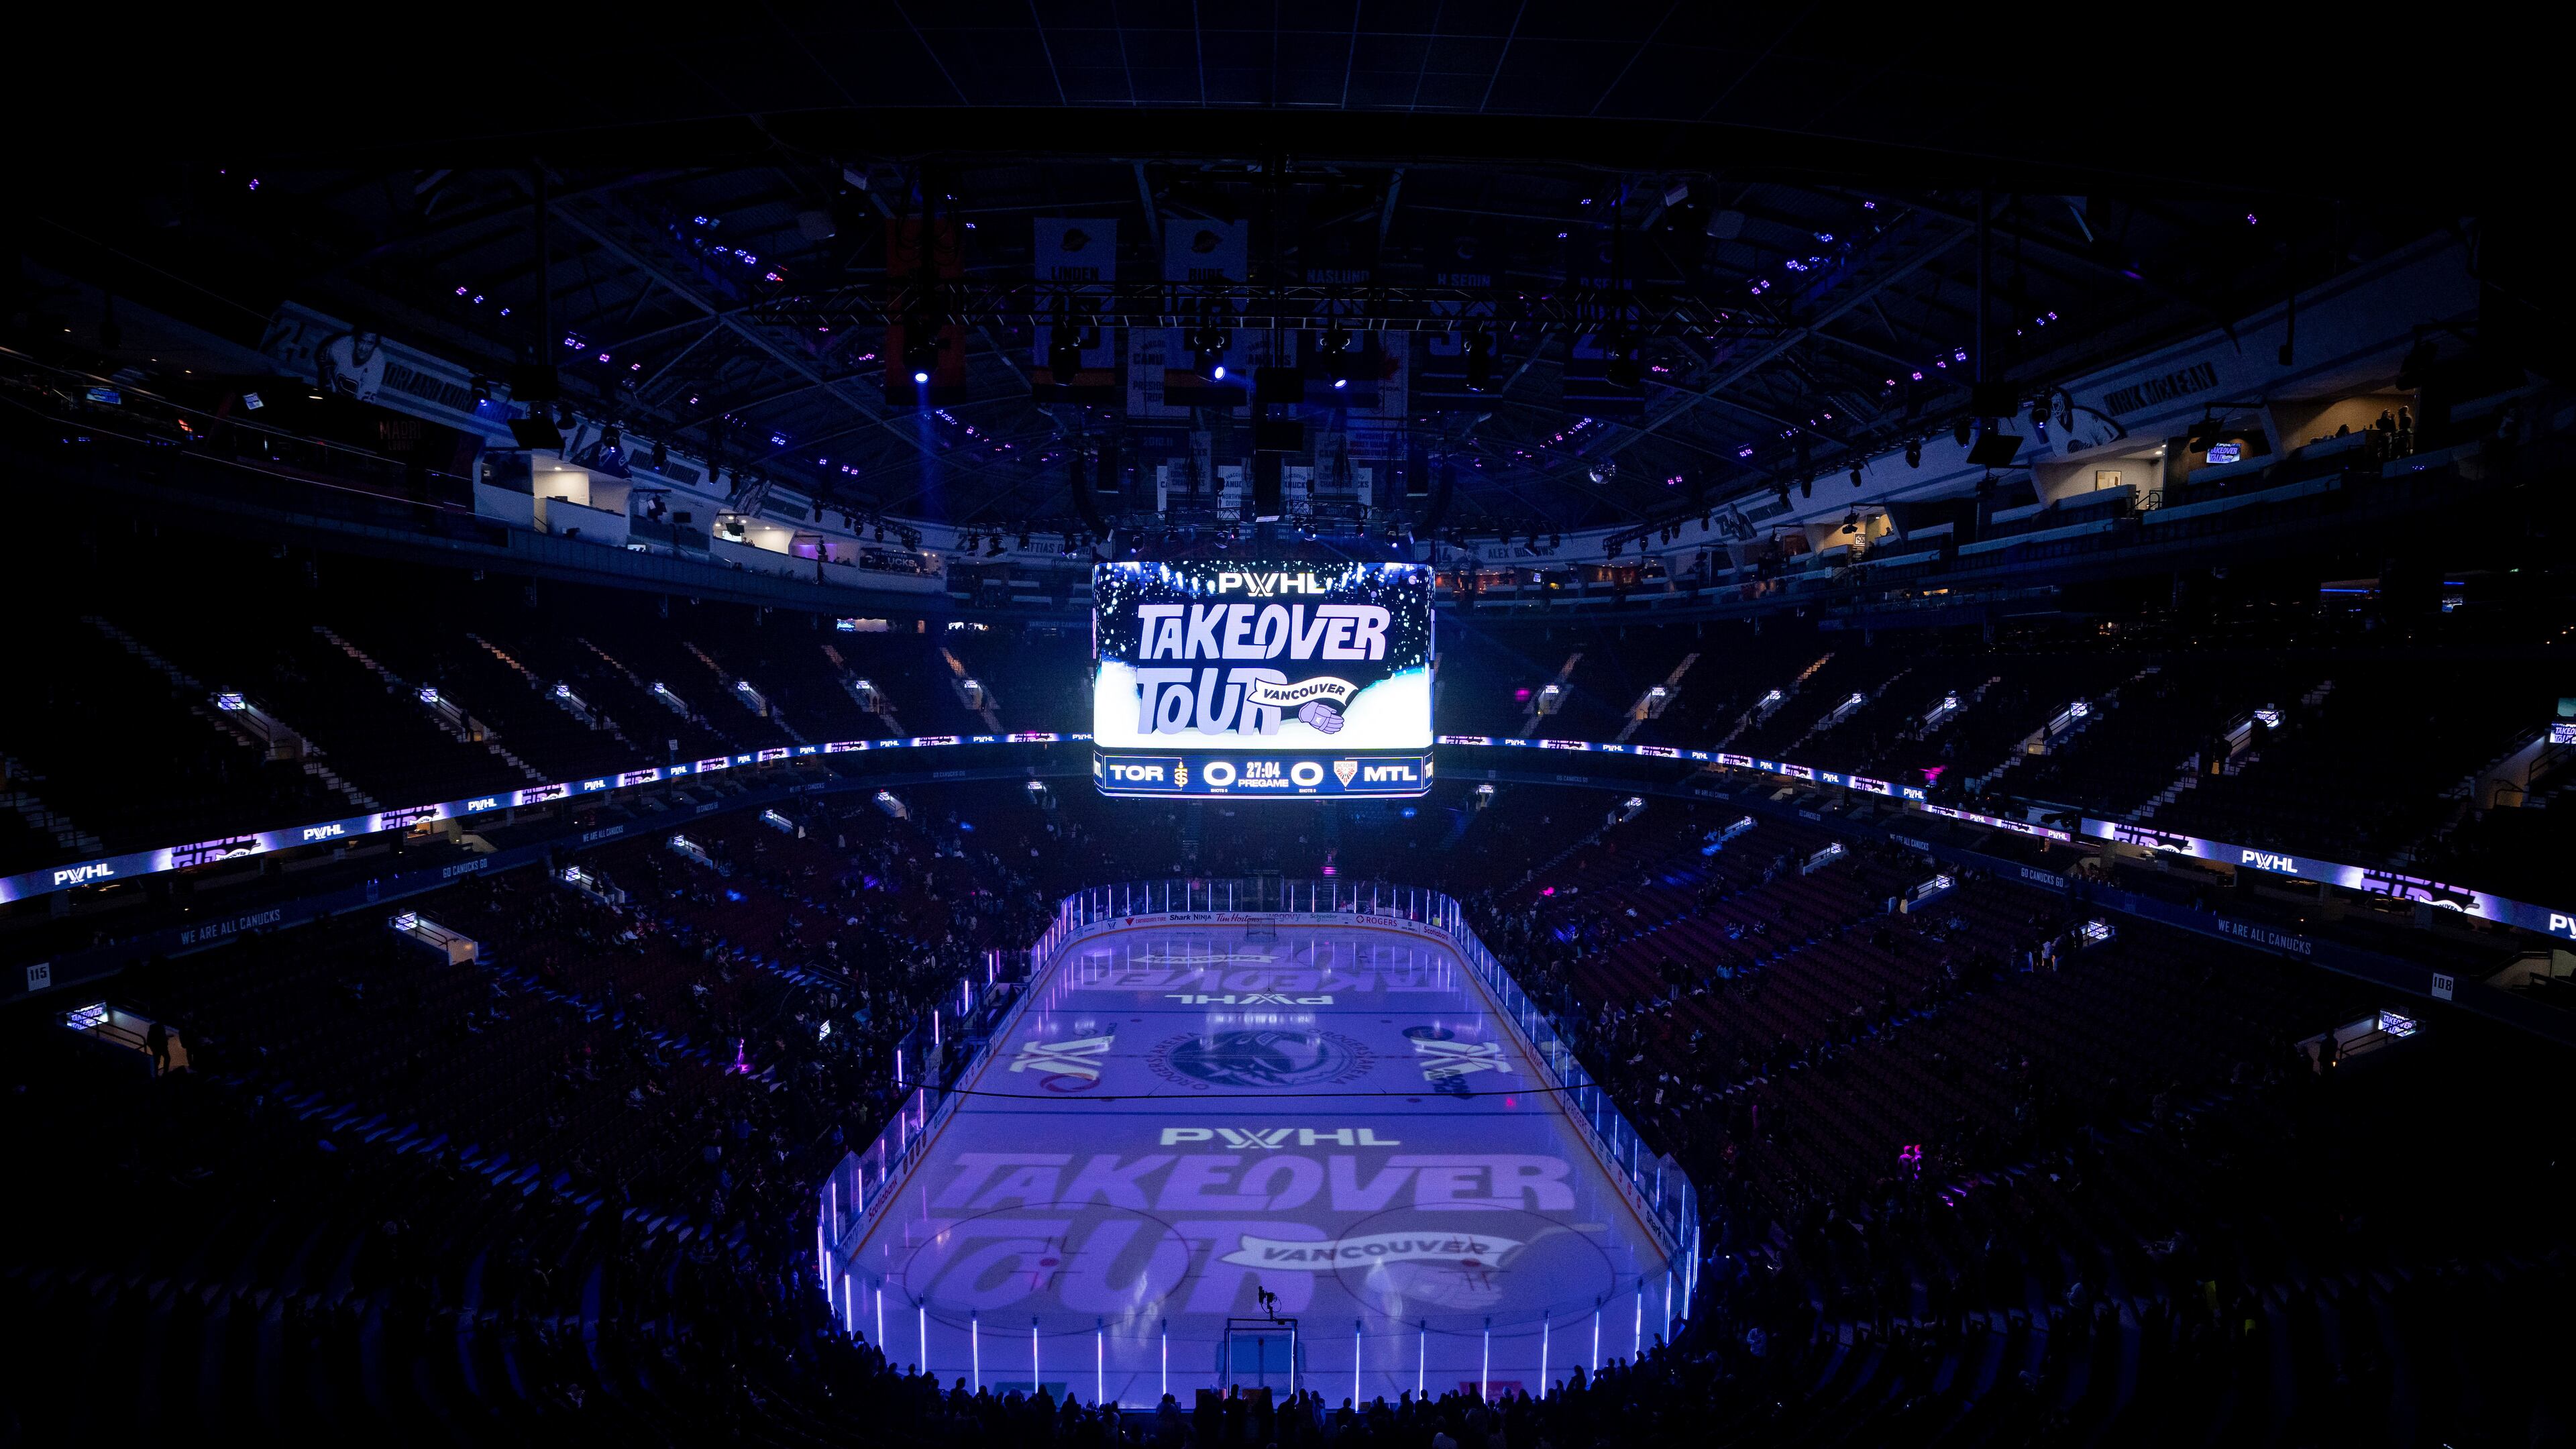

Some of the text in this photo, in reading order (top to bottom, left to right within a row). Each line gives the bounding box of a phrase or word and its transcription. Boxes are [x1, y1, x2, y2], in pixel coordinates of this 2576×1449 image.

[1052, 268, 1099, 281] LINDEN
[1307, 269, 1371, 283] NASLUND
[2104, 385, 2146, 416] KIRK
[1489, 548, 1509, 559] ALEX
[1219, 572, 1326, 597] PWHL
[1138, 603, 1391, 661] TAKEOVER
[1263, 682, 1347, 702] VANCOUVER
[1136, 667, 1289, 736] TOUR
[671, 766, 687, 775] PWHL
[1110, 765, 1164, 781] TOR
[1246, 761, 1281, 778] 27:04
[1364, 766, 1417, 782] MTL
[1823, 773, 1839, 782] PWHL
[585, 780, 605, 790] PWHL
[1238, 779, 1289, 788] PREGAME
[1904, 788, 1923, 799] PWHL
[468, 798, 496, 810] PWHL
[1970, 814, 1986, 822] PWHL
[304, 824, 344, 840] PWHL
[2048, 830, 2068, 840] PWHL
[443, 859, 488, 878] GO CANUCKS GO
[2243, 851, 2298, 873] PWHL
[54, 863, 113, 885] PWHL
[2021, 867, 2063, 888] GO CANUCKS GO
[1193, 913, 1212, 921] NINJA
[1216, 913, 1231, 922] Tim
[1266, 912, 1301, 922] wegovy
[1366, 916, 1397, 927] ROGERS
[180, 909, 281, 945] WE ARE ALL CANUCKS
[1424, 926, 1449, 940] Scotiabank
[2218, 918, 2312, 955] WE ARE ALL CANUCKS
[30, 967, 47, 981] 115
[2434, 977, 2452, 991] 108
[1164, 994, 1334, 1005] PWHL
[1160, 1127, 1400, 1150] PWHL
[930, 1152, 1576, 1212] TAKEOVER
[869, 1175, 898, 1222] Scotiabank
[1646, 1210, 1663, 1240] Shark
[1260, 1238, 1501, 1265] VANCOUVER
[907, 1218, 1330, 1316] TOUR
